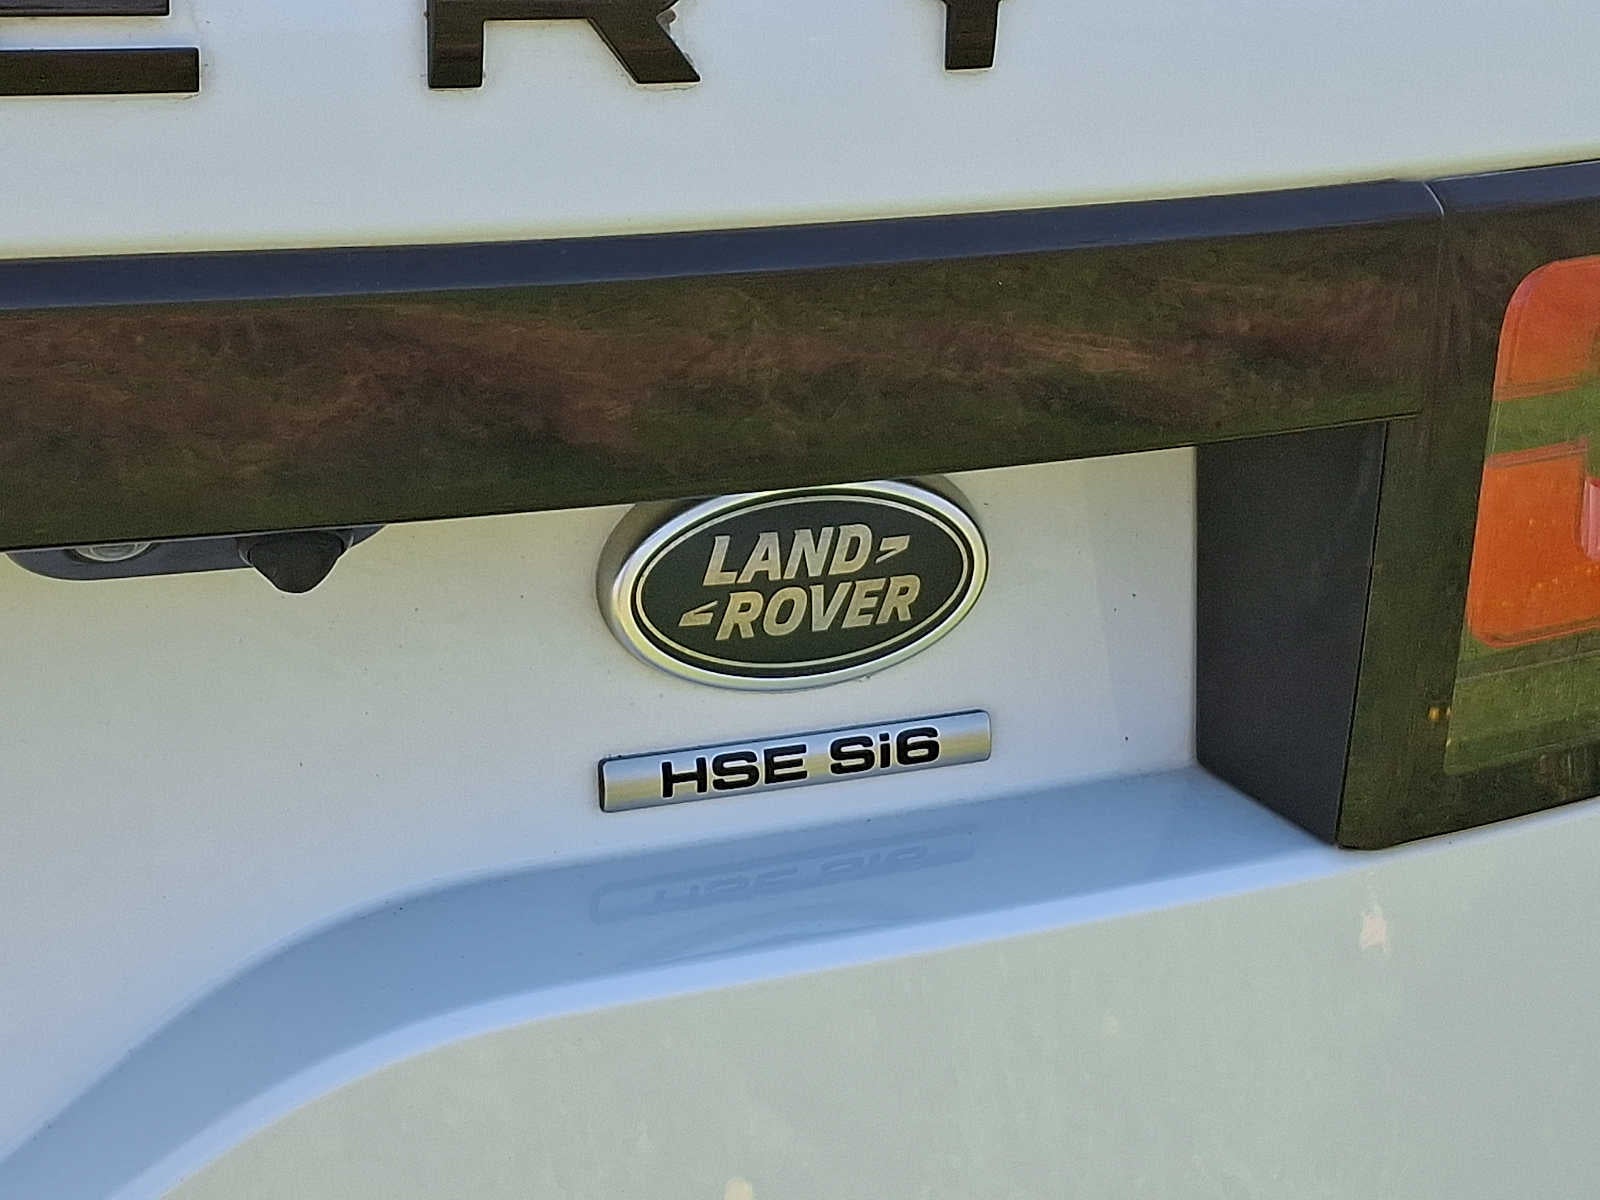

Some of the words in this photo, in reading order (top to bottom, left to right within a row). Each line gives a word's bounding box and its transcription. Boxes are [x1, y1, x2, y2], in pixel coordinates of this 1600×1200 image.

[702, 523, 871, 586] LAND
[715, 574, 920, 640] ROVER
[661, 743, 808, 798] HSE
[828, 726, 941, 775] Si6
